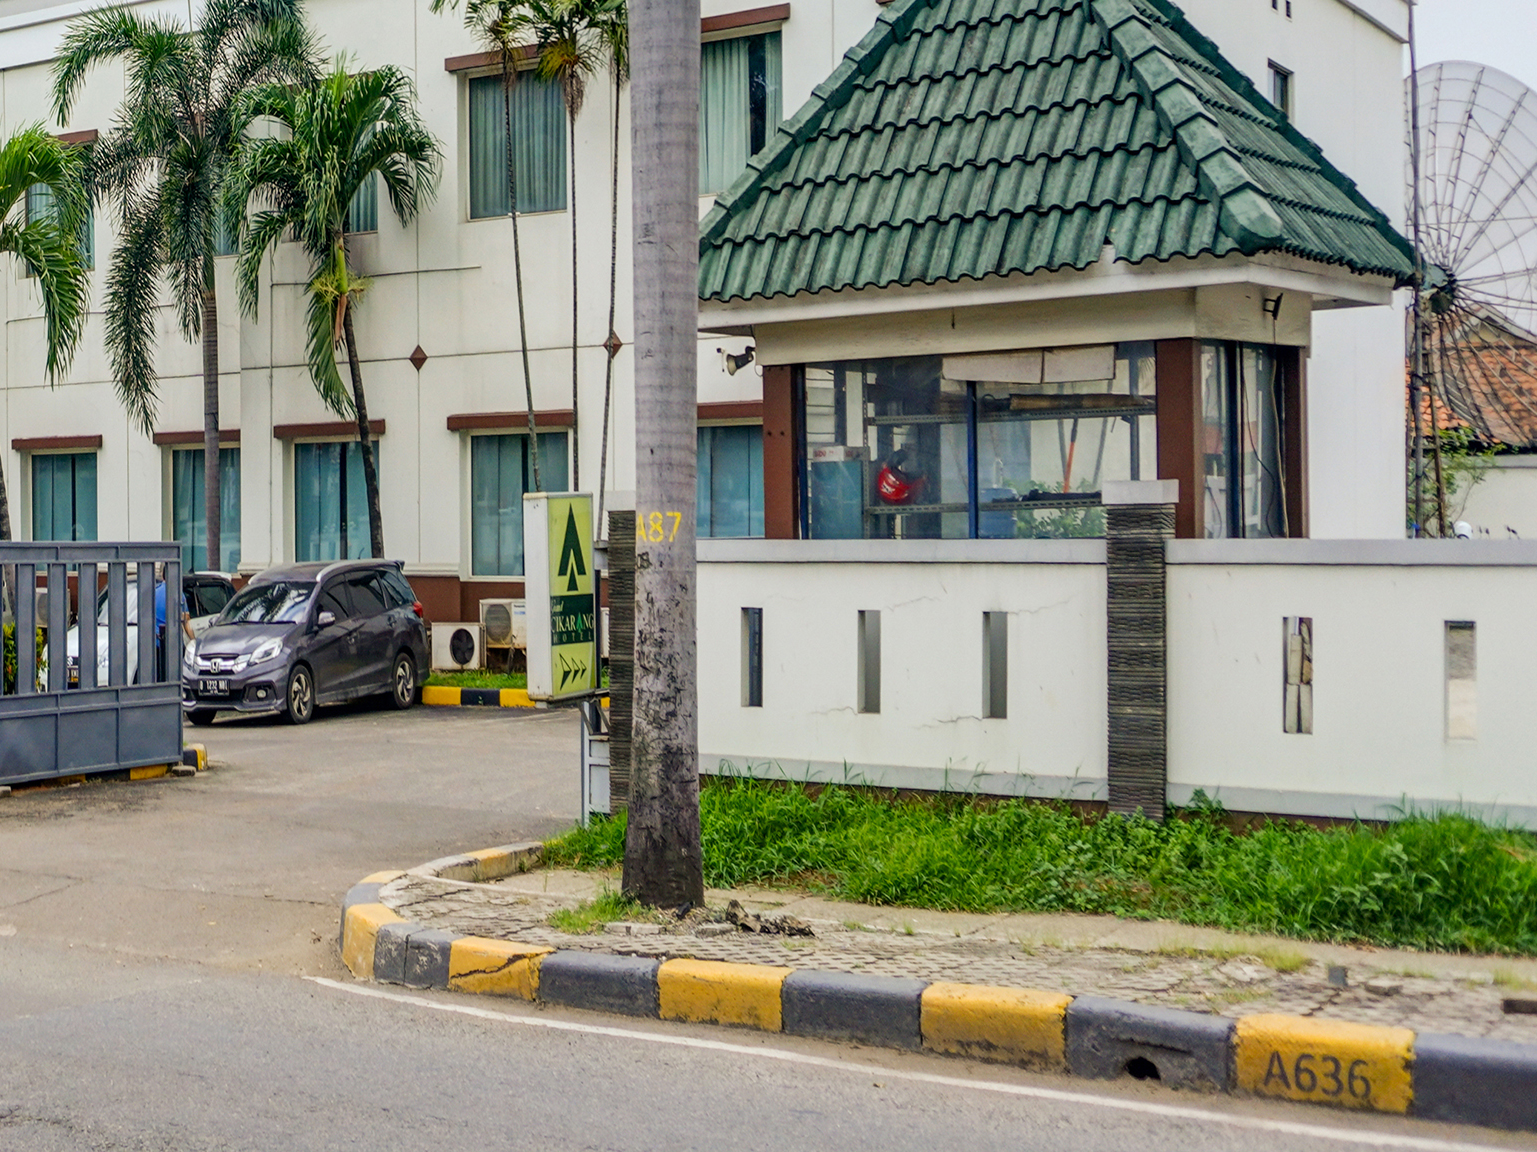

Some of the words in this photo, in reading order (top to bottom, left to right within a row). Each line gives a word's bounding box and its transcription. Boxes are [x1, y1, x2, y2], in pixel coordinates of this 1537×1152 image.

[635, 511, 682, 542] A87
[551, 612, 594, 633] CIKARANG
[553, 631, 592, 644] HOTEL
[1263, 1051, 1371, 1101] A636
